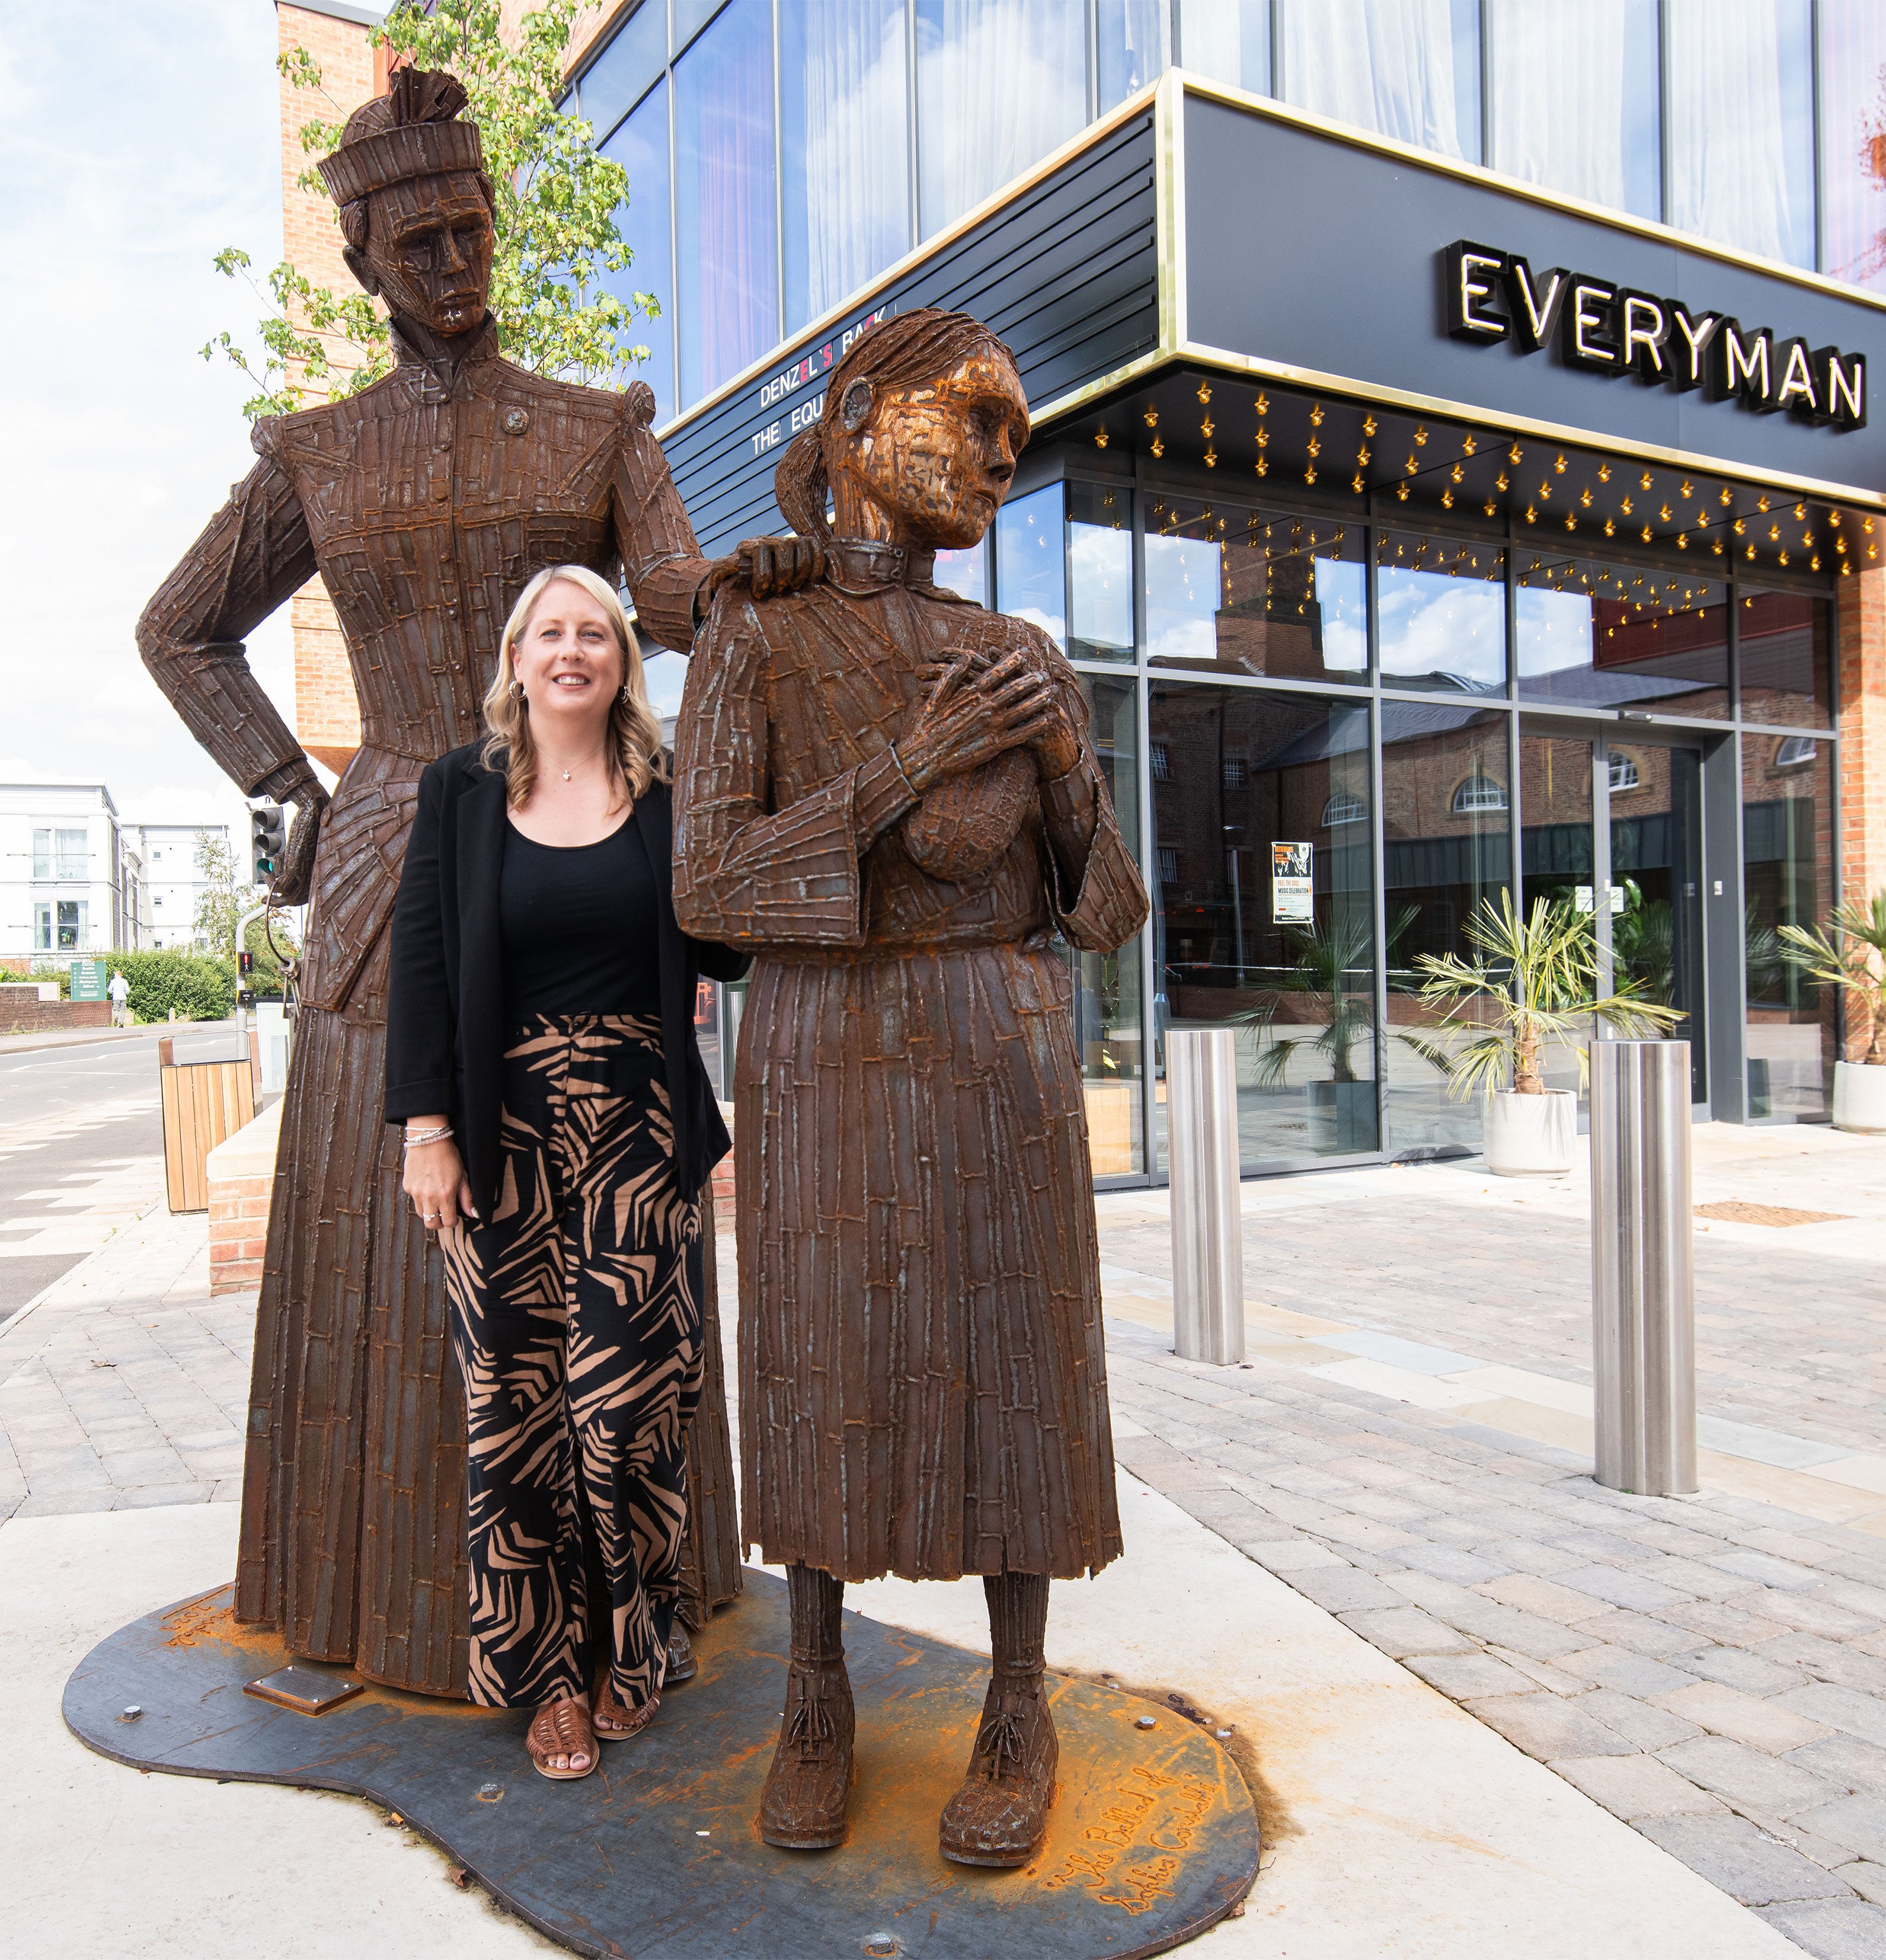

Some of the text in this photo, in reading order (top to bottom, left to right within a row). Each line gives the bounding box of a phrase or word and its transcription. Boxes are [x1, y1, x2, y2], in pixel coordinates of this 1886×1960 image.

[1452, 241, 1866, 428] EVERYMAN
[752, 422, 780, 455] THE
[1086, 1788, 1155, 1847] Ballad
[1132, 1768, 1179, 1789] of
